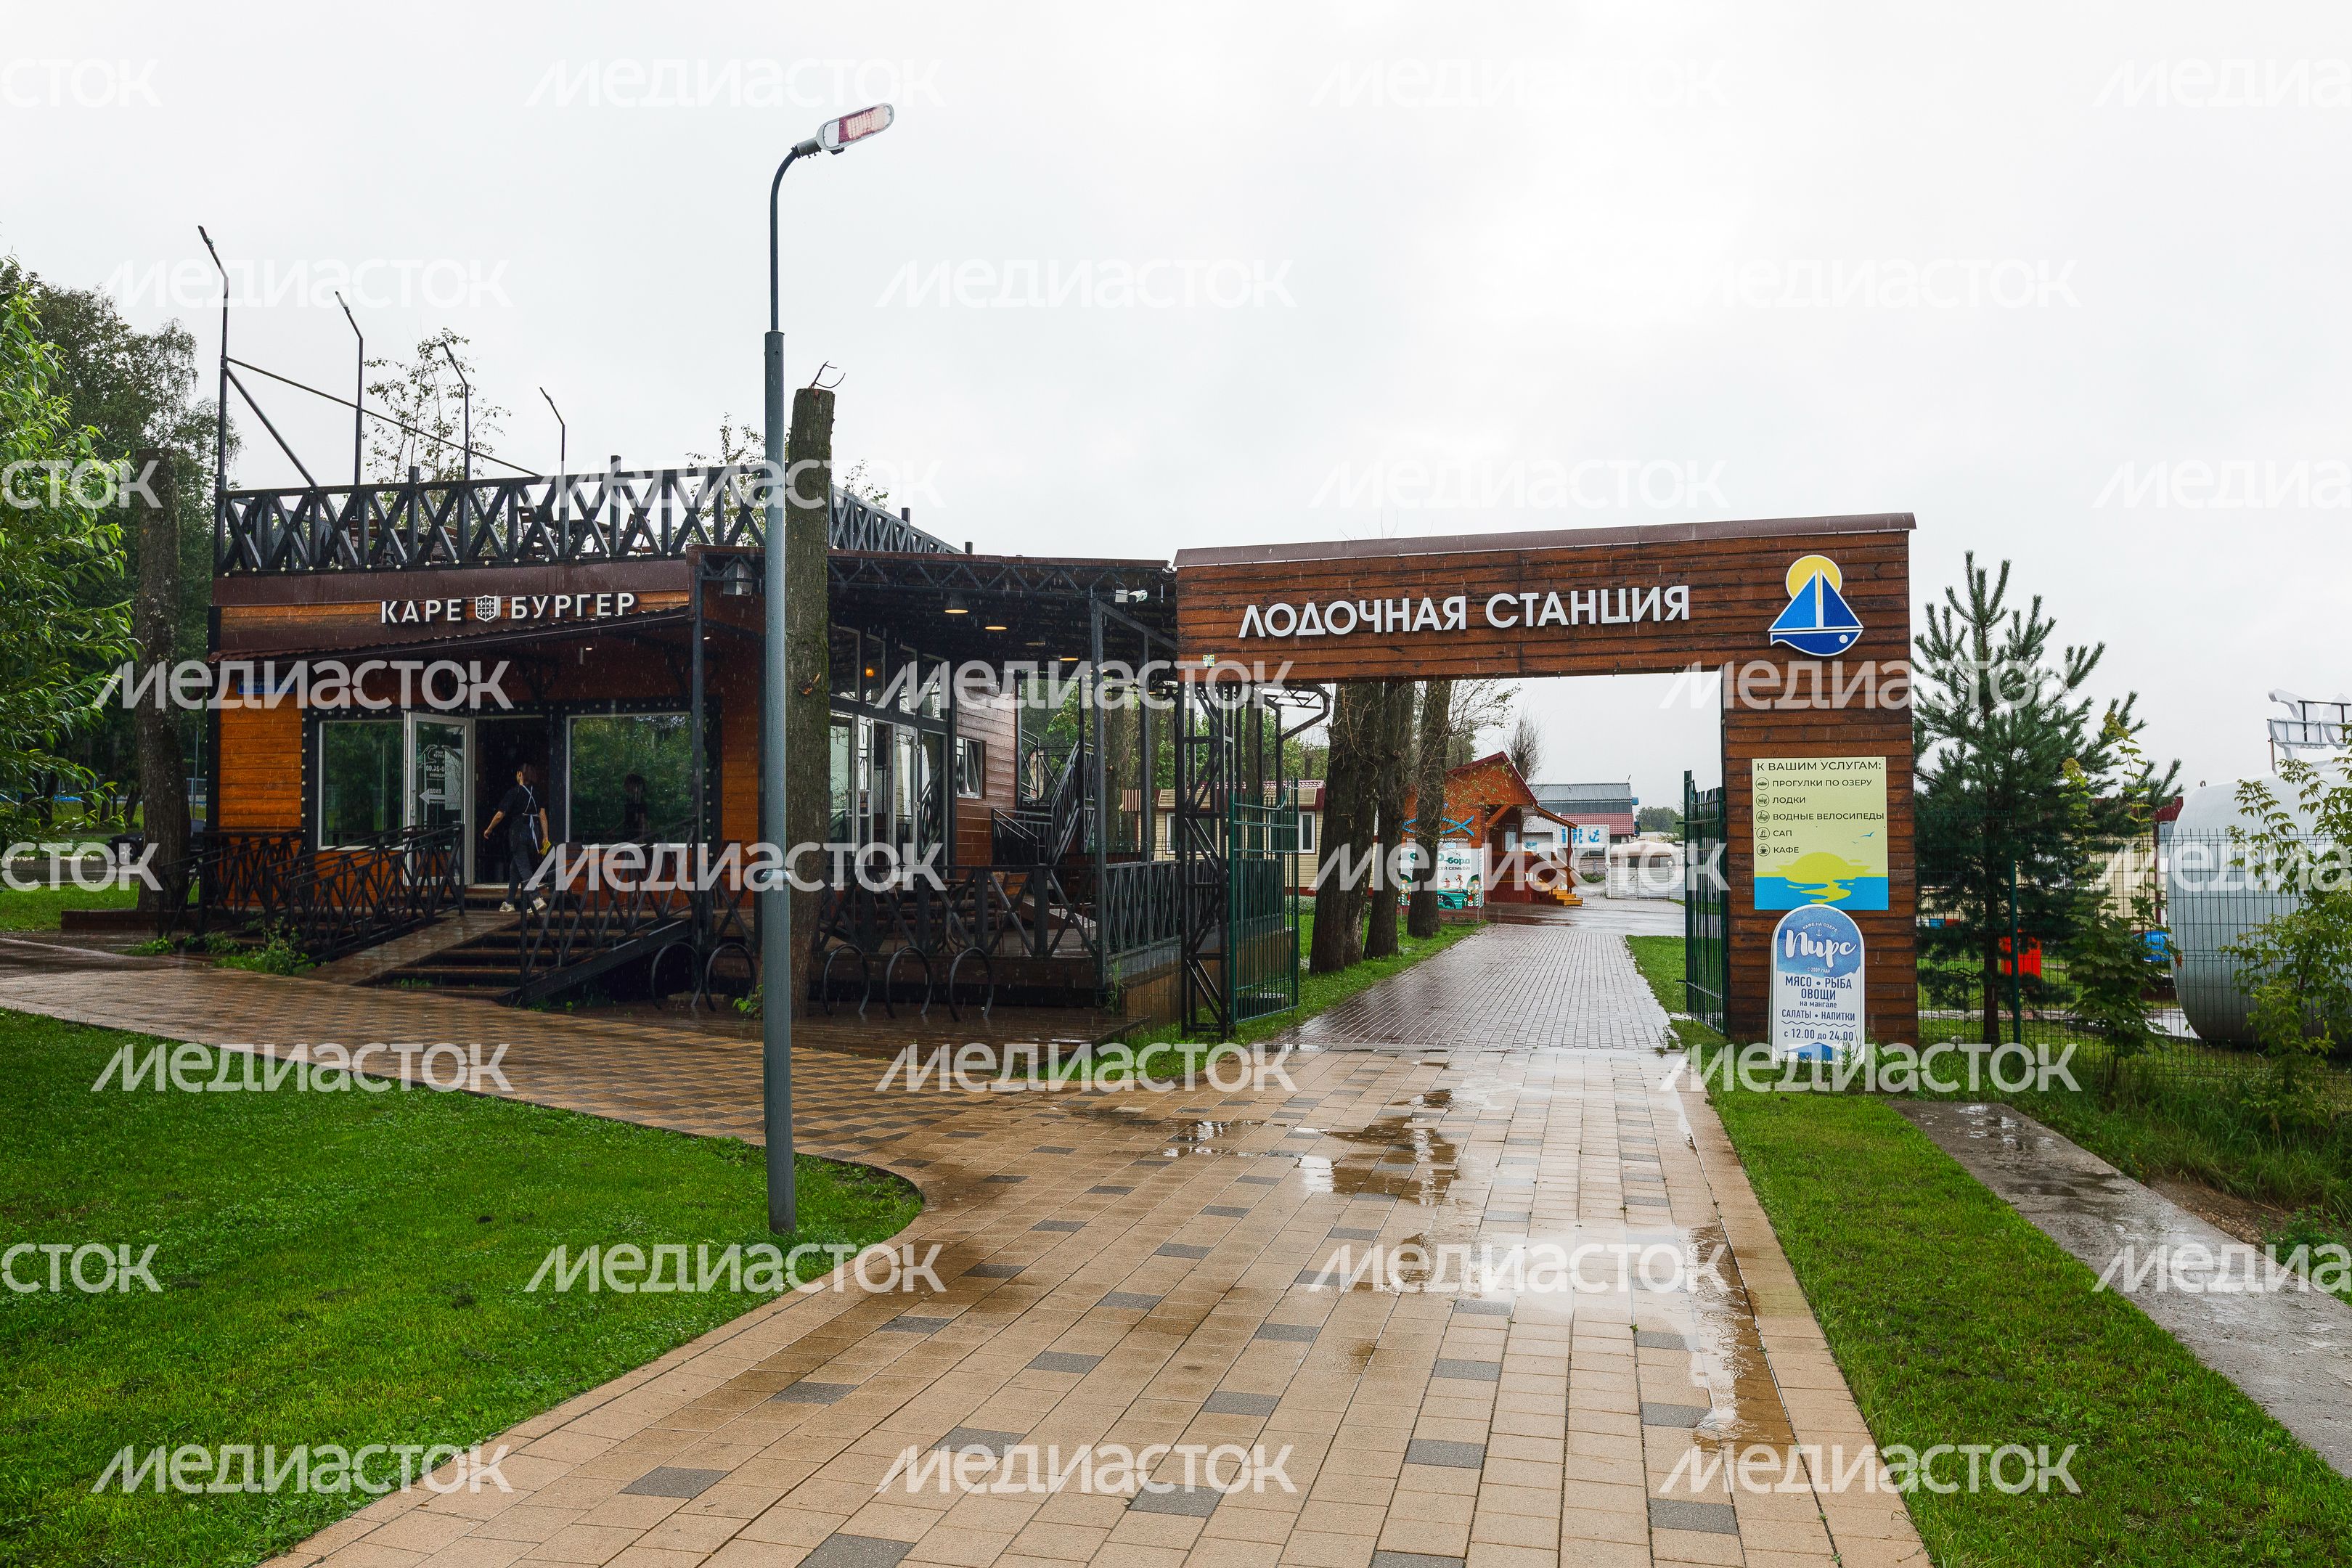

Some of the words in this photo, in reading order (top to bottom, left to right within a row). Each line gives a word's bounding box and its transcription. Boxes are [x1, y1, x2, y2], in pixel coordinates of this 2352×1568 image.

[381, 598, 462, 624] КАРЕ
[511, 592, 635, 619] БУРГЕР
[1238, 596, 1466, 638] ЛОДОЧНАЯ
[1486, 585, 1690, 629] СТАНЦИЯ
[1768, 762, 1817, 771] ВАШИМ
[1821, 761, 1882, 770] УСЛУГАМ:
[1823, 923, 1838, 933] ОЗЕРЕ
[1786, 930, 1856, 968] Пирс
[1785, 976, 1812, 987] МЯСО
[1825, 978, 1852, 989] РЫБА
[1801, 988, 1836, 1001] ОВОЩИ
[1781, 1009, 1811, 1018] САЛАТЫ
[1821, 1011, 1855, 1021] НАПИТКИ
[1791, 1029, 1815, 1039] 12.00
[1829, 1031, 1853, 1041] 24.00
